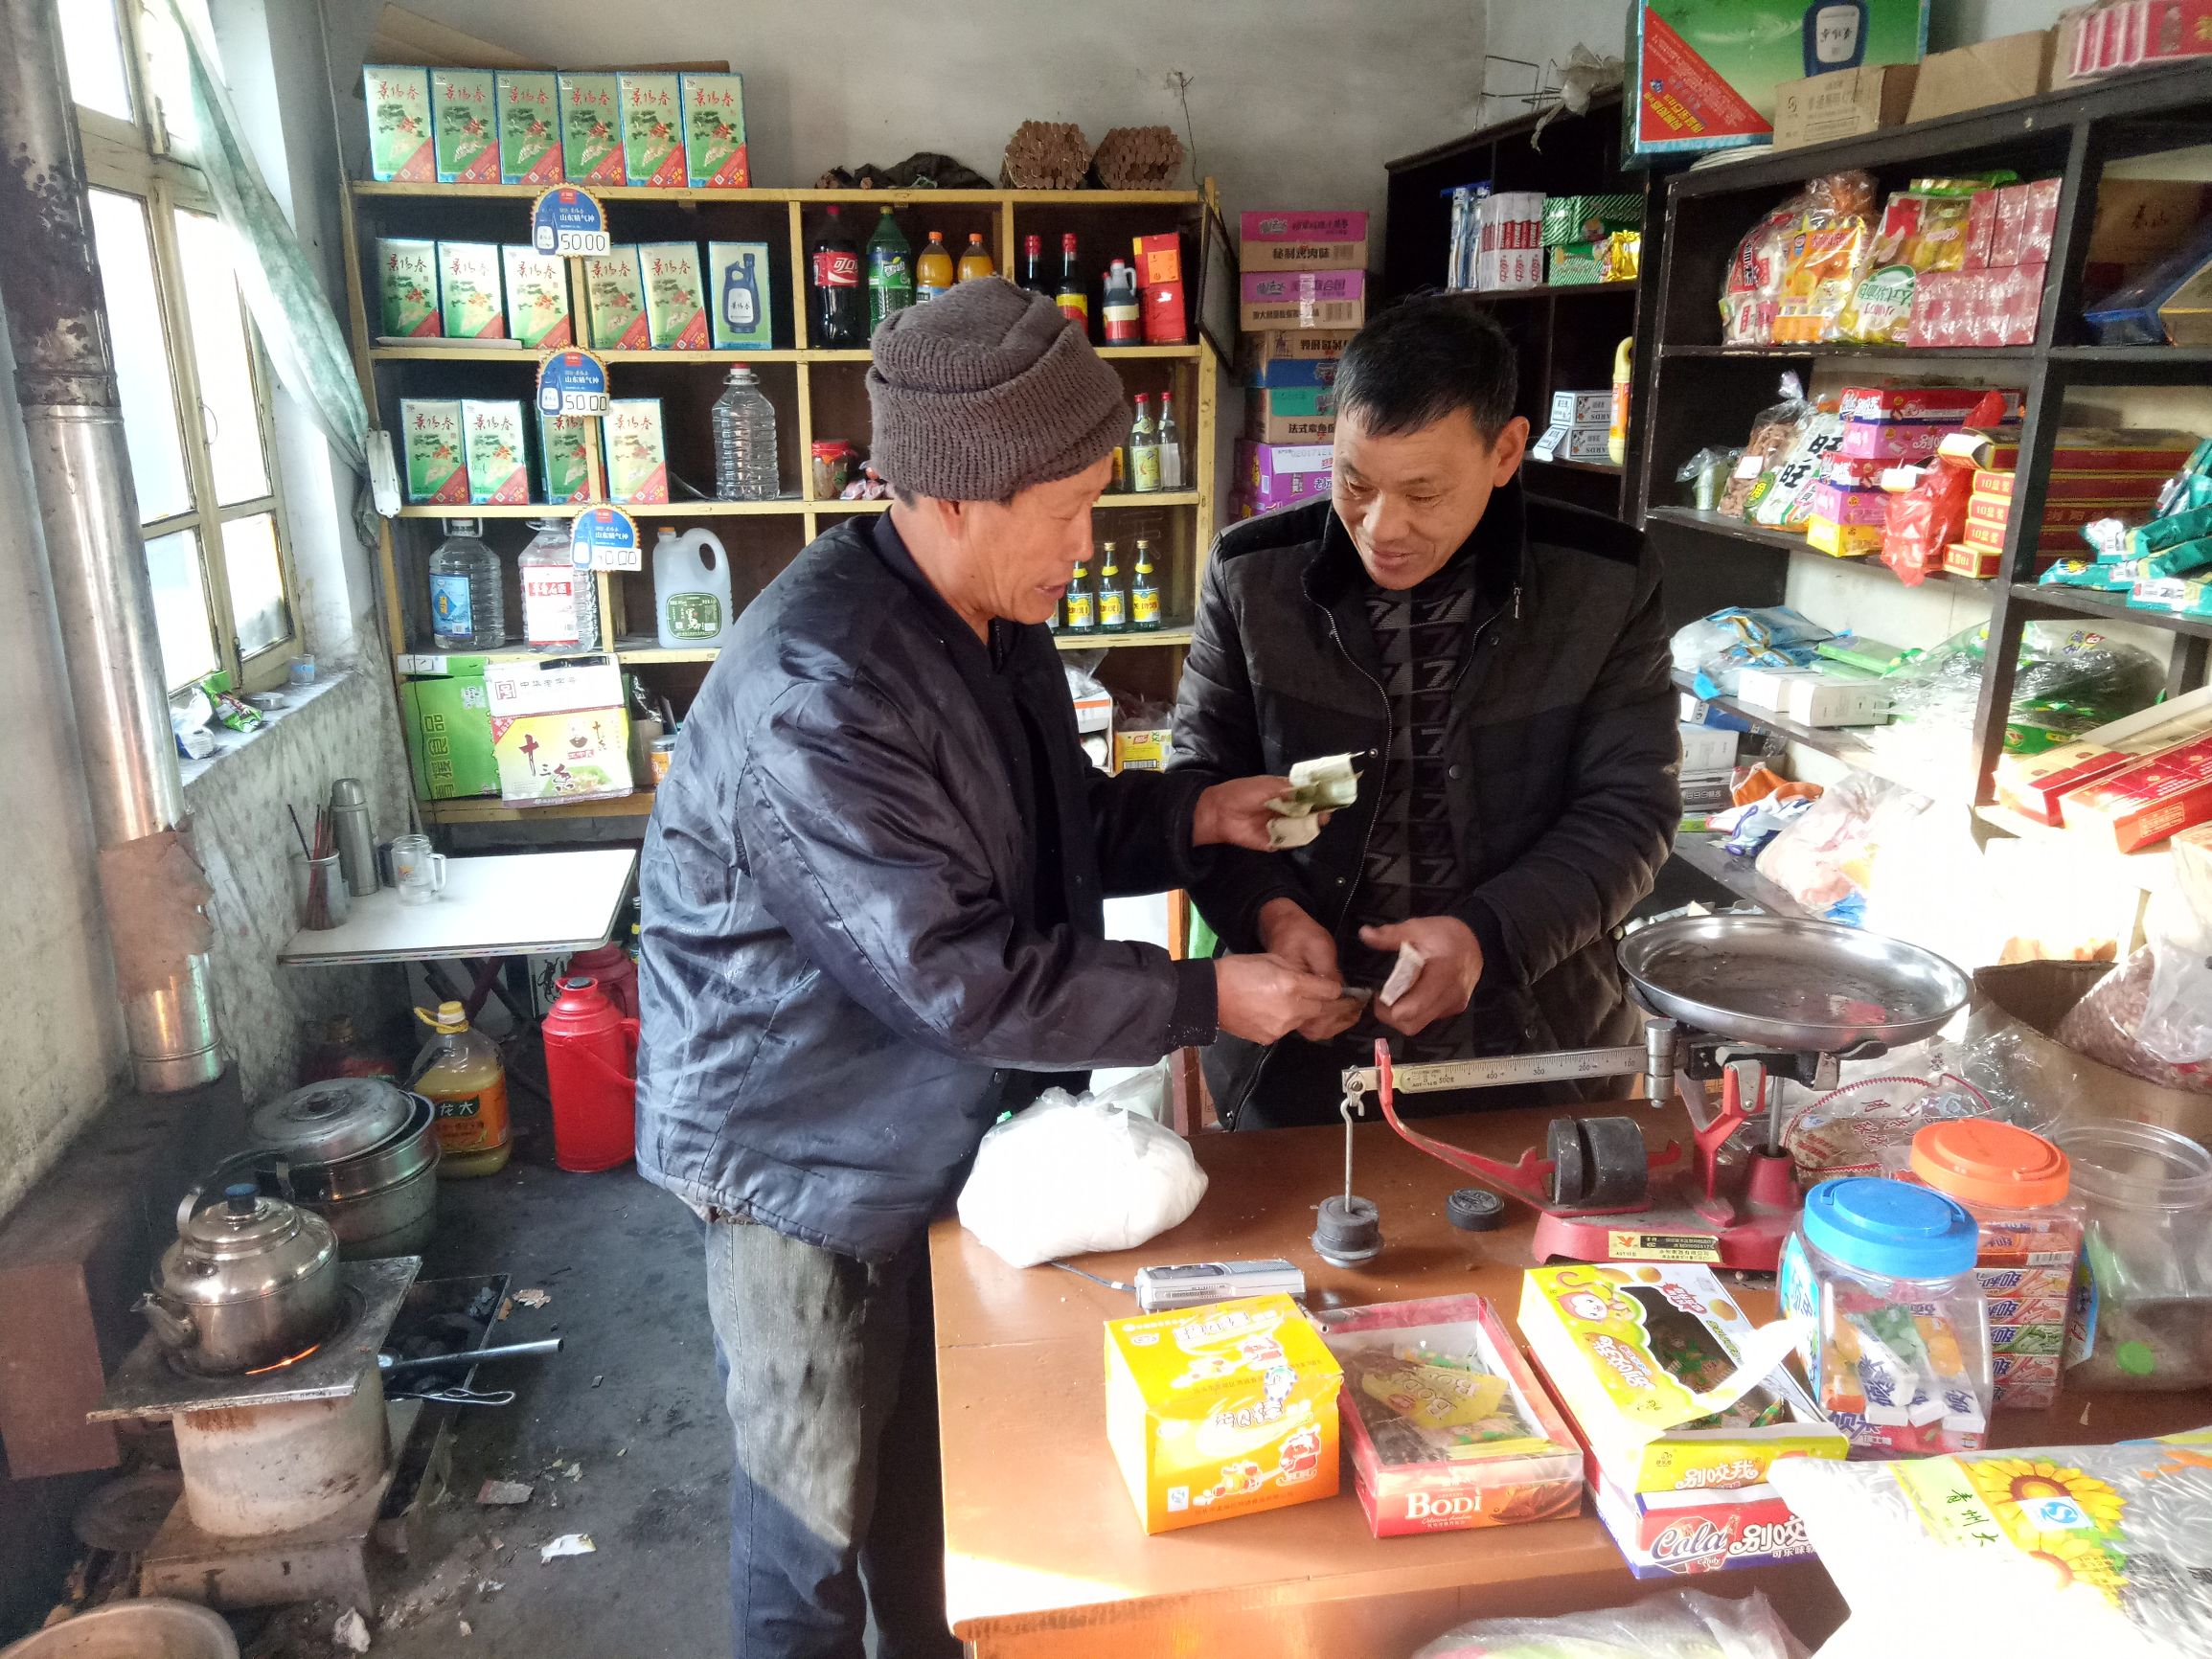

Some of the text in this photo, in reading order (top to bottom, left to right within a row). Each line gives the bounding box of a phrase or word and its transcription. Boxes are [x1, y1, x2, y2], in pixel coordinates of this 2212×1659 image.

[1675, 1459, 1759, 1489] 别咬我
[1651, 1521, 1727, 1561] Cola
